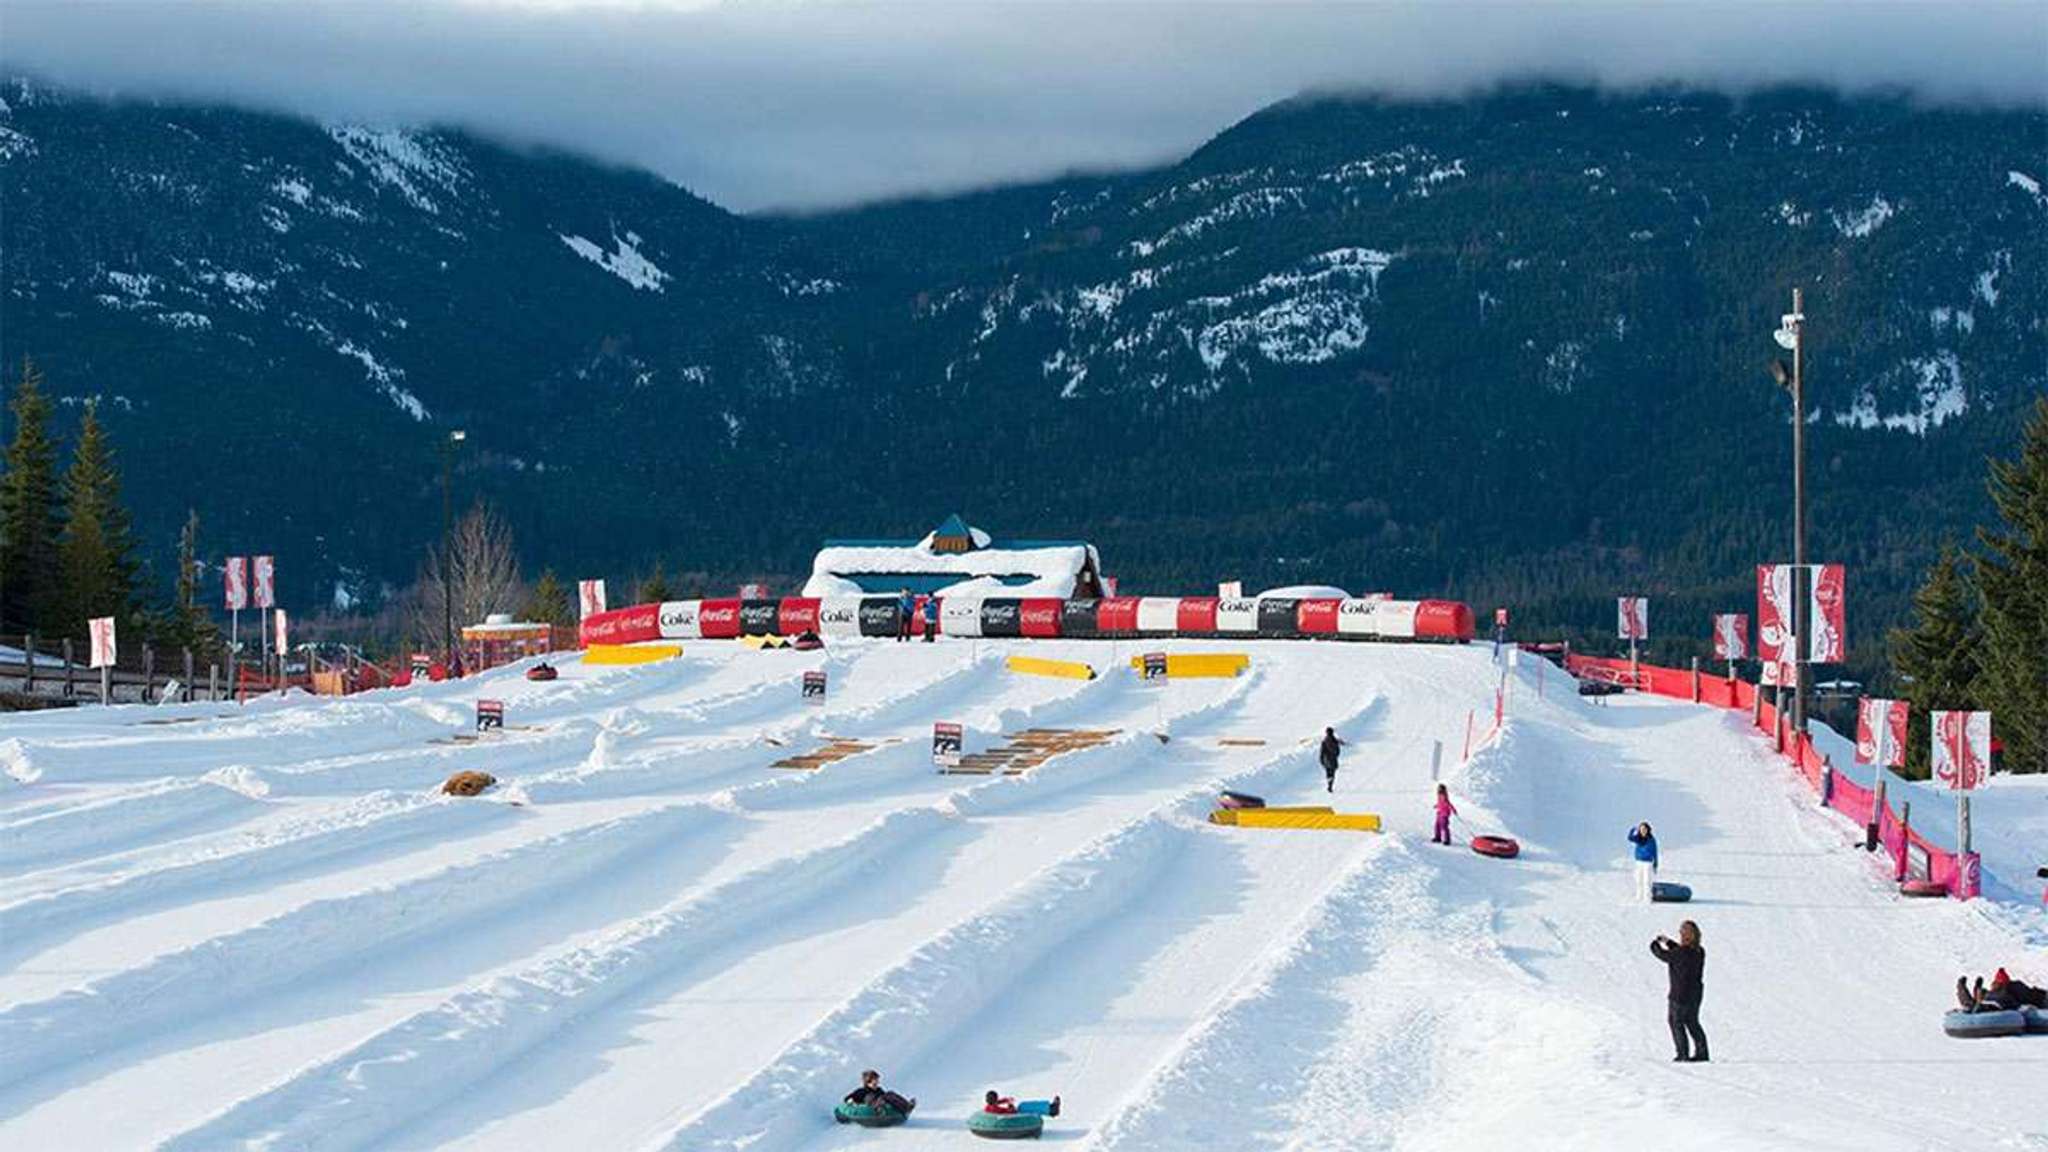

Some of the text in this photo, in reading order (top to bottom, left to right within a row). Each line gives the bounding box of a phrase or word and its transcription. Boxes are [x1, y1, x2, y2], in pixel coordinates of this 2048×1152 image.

[1219, 601, 1251, 613] Coke
[1340, 603, 1374, 615] Coke
[661, 613, 692, 626] Coke
[820, 609, 850, 623] Coke
